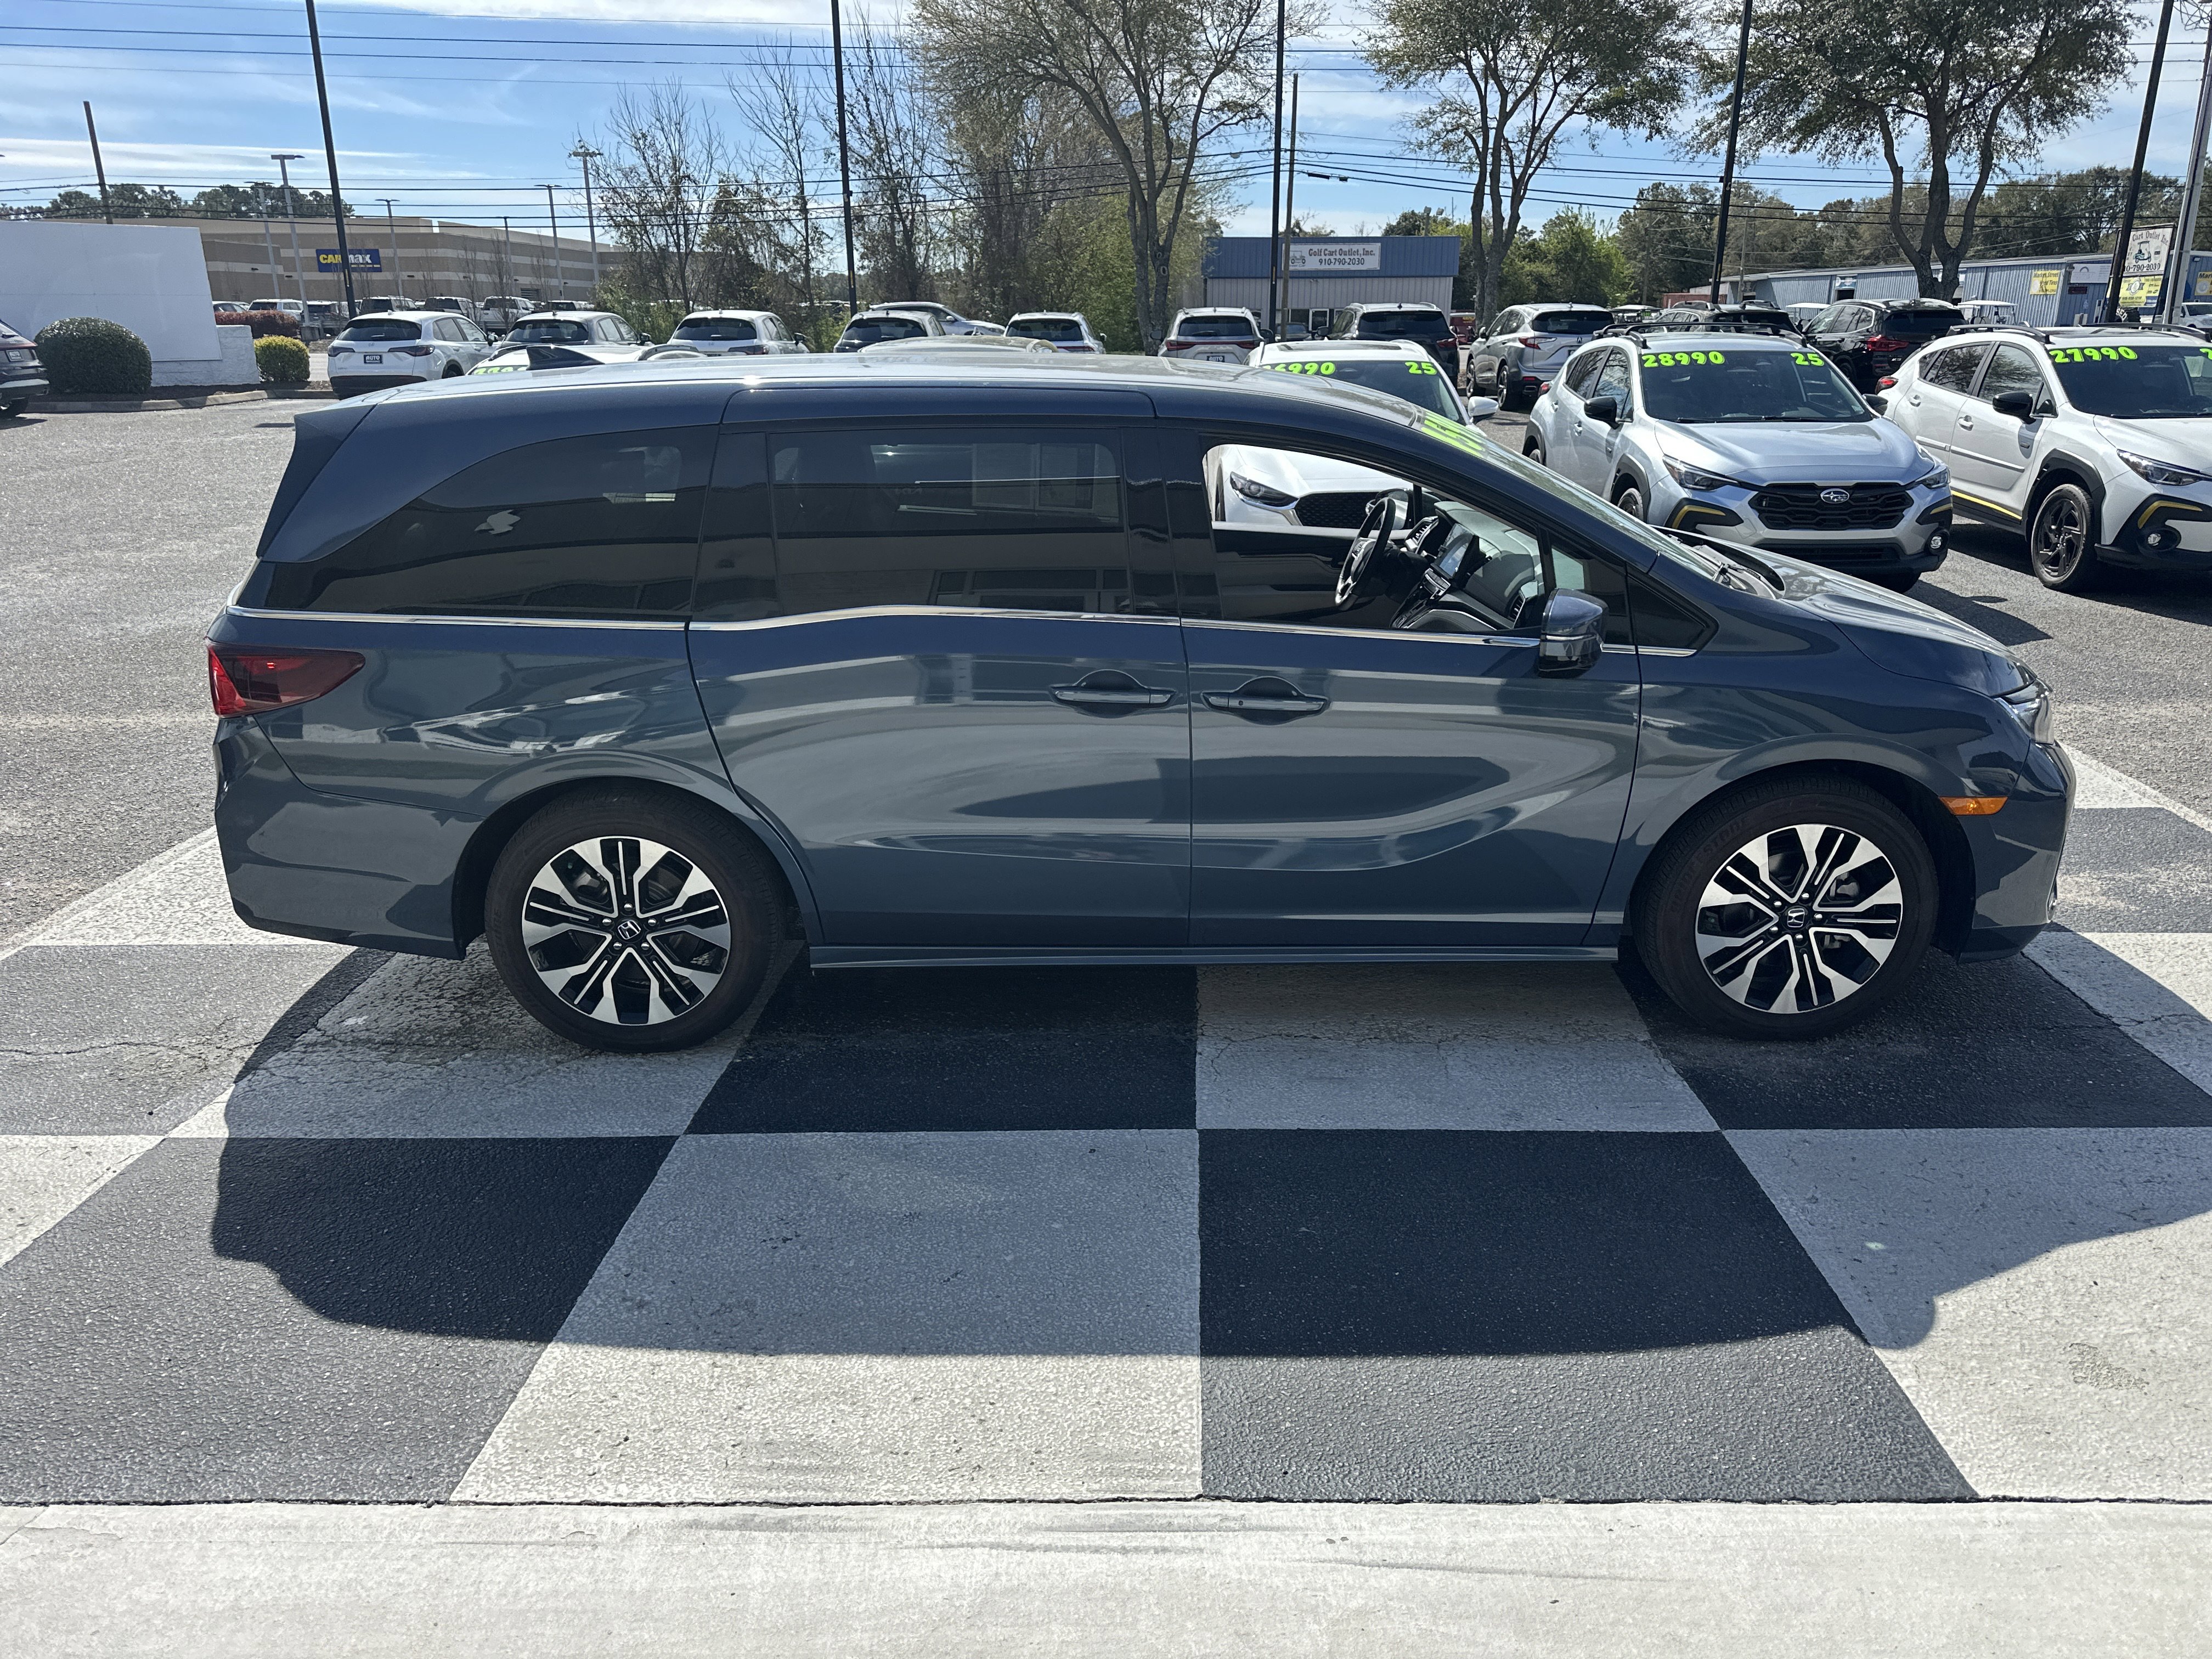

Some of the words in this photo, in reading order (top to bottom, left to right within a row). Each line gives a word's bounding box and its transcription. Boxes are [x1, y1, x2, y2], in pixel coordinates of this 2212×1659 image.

[2132, 233, 2143, 241] Cart
[2146, 231, 2160, 240] Outlet
[1308, 249, 1323, 257] Golf
[2126, 262, 2161, 272] 0-790-2030
[2115, 308, 2128, 320] SED
[1642, 351, 1725, 368] 28990
[1791, 352, 1825, 366] 25
[2049, 346, 2138, 363] 27990
[1263, 362, 1336, 375] 6990
[1405, 362, 1437, 375] 25
